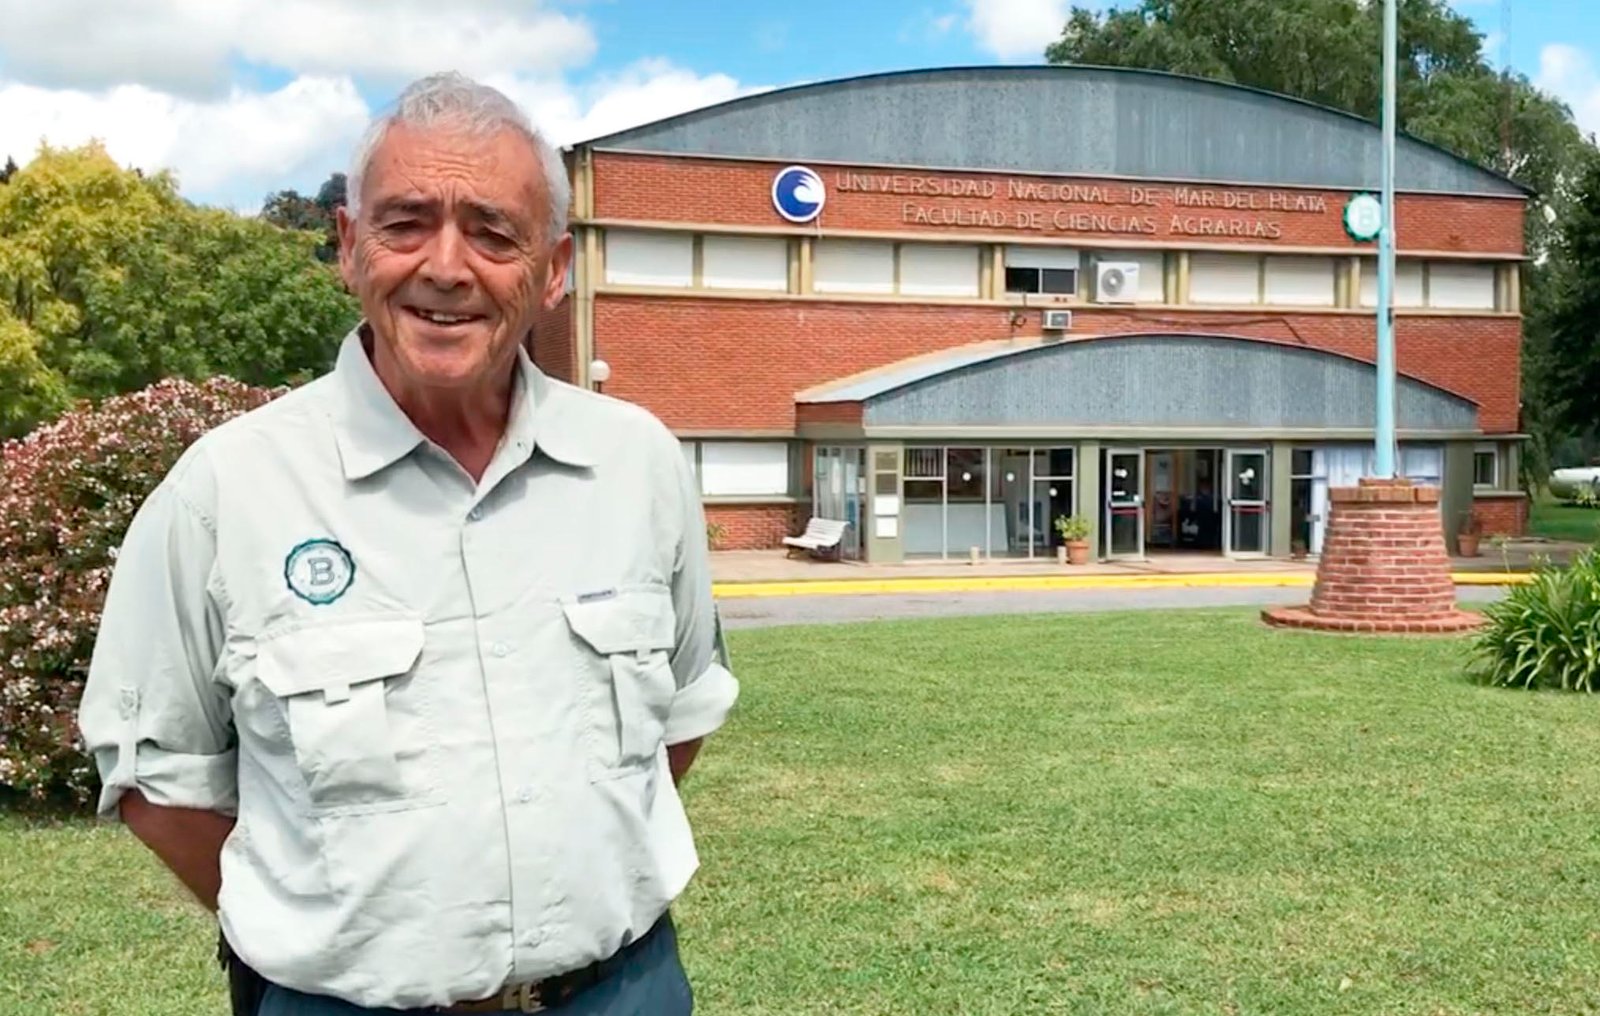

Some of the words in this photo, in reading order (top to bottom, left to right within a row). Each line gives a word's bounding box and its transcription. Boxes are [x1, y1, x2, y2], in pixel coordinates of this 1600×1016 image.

[835, 171, 995, 198] UNIVERSIDAD
[1007, 179, 1111, 204] NACIONAL
[1130, 186, 1160, 205] DE
[1174, 187, 1217, 207] MAR
[1223, 191, 1260, 209] DEL
[1270, 192, 1327, 212] PLATA
[902, 203, 1006, 226] FACULTAD
[1016, 211, 1041, 229] DE
[1053, 210, 1156, 233] CIENCIAS
[1169, 215, 1281, 238] AGRARIAS
[307, 557, 335, 586] B
